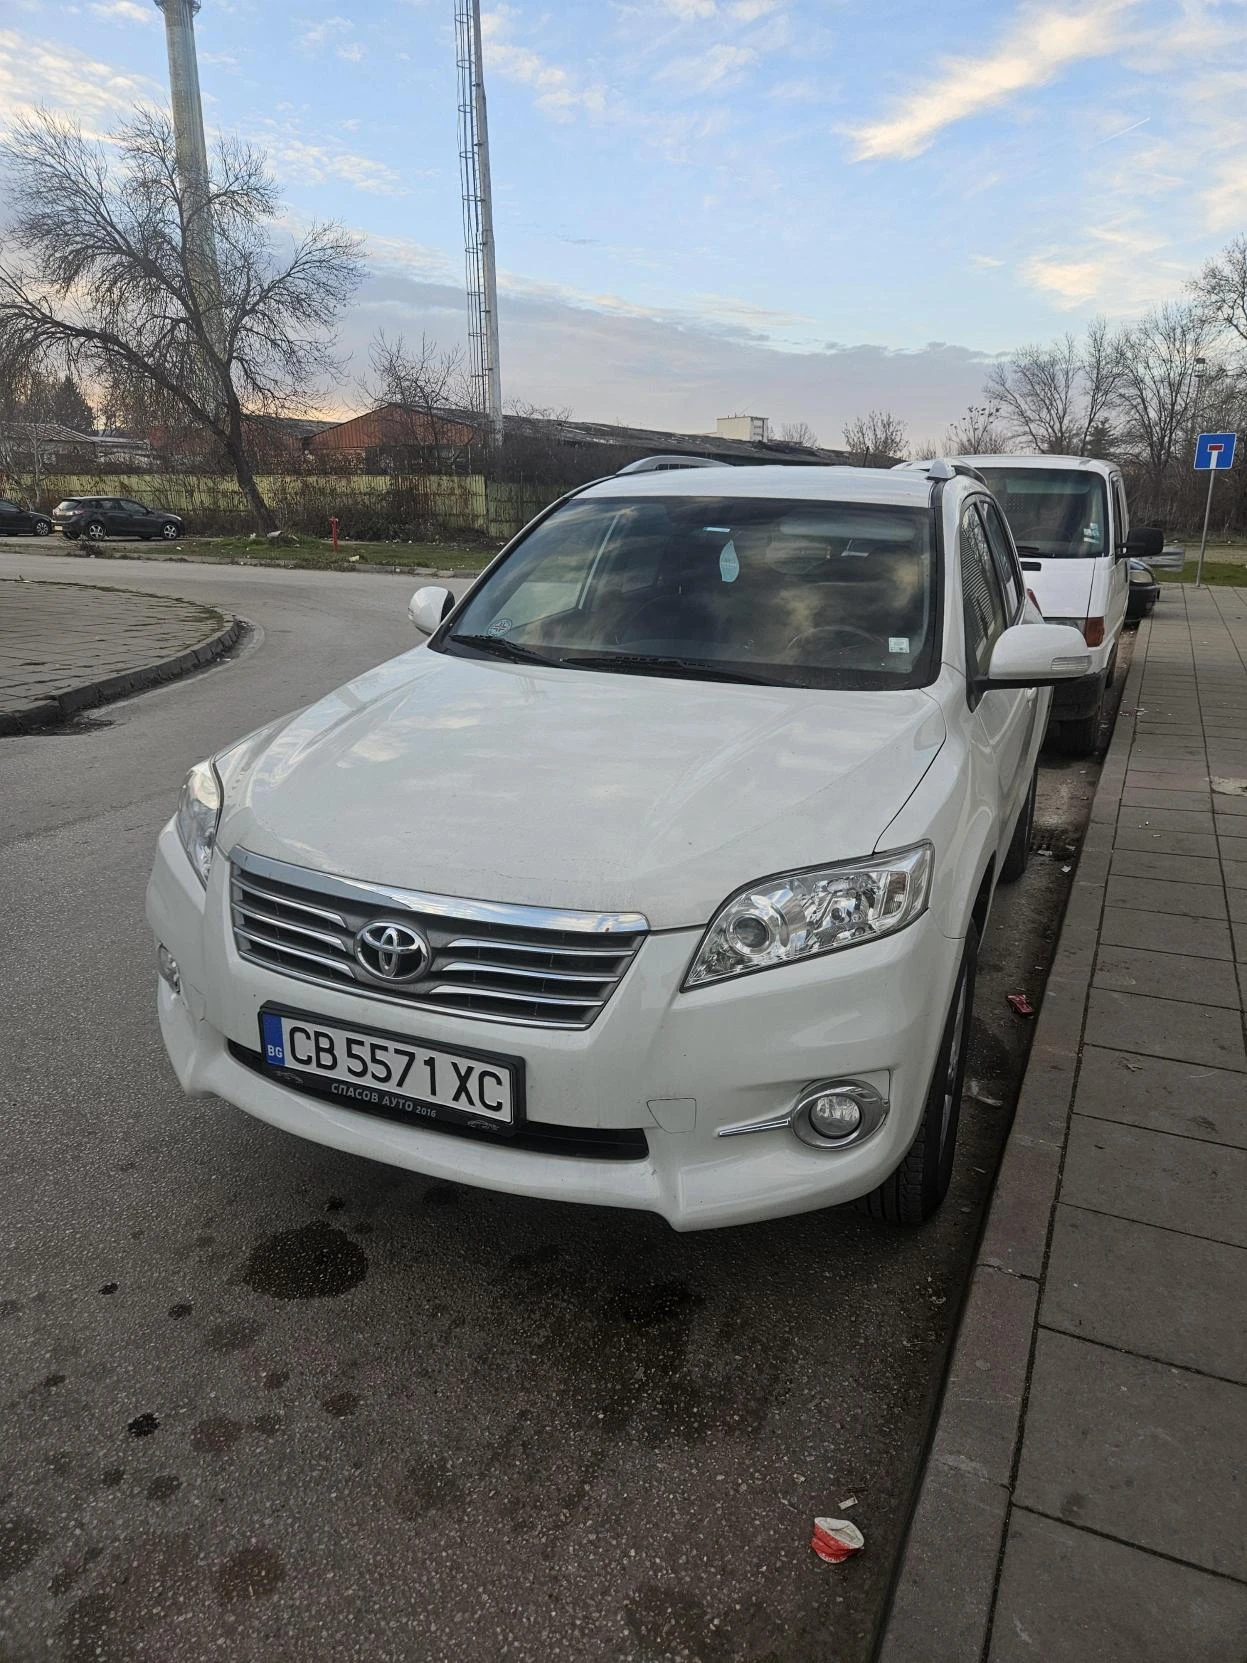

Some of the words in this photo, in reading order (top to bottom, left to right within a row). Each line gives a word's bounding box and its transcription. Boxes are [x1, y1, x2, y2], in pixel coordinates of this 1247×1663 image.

[267, 1044, 283, 1058] BG
[345, 1037, 437, 1097] 5571
[331, 1083, 379, 1103] СПАСОВ
[382, 1096, 414, 1112] АУТО
[415, 1106, 437, 1118] 2016
